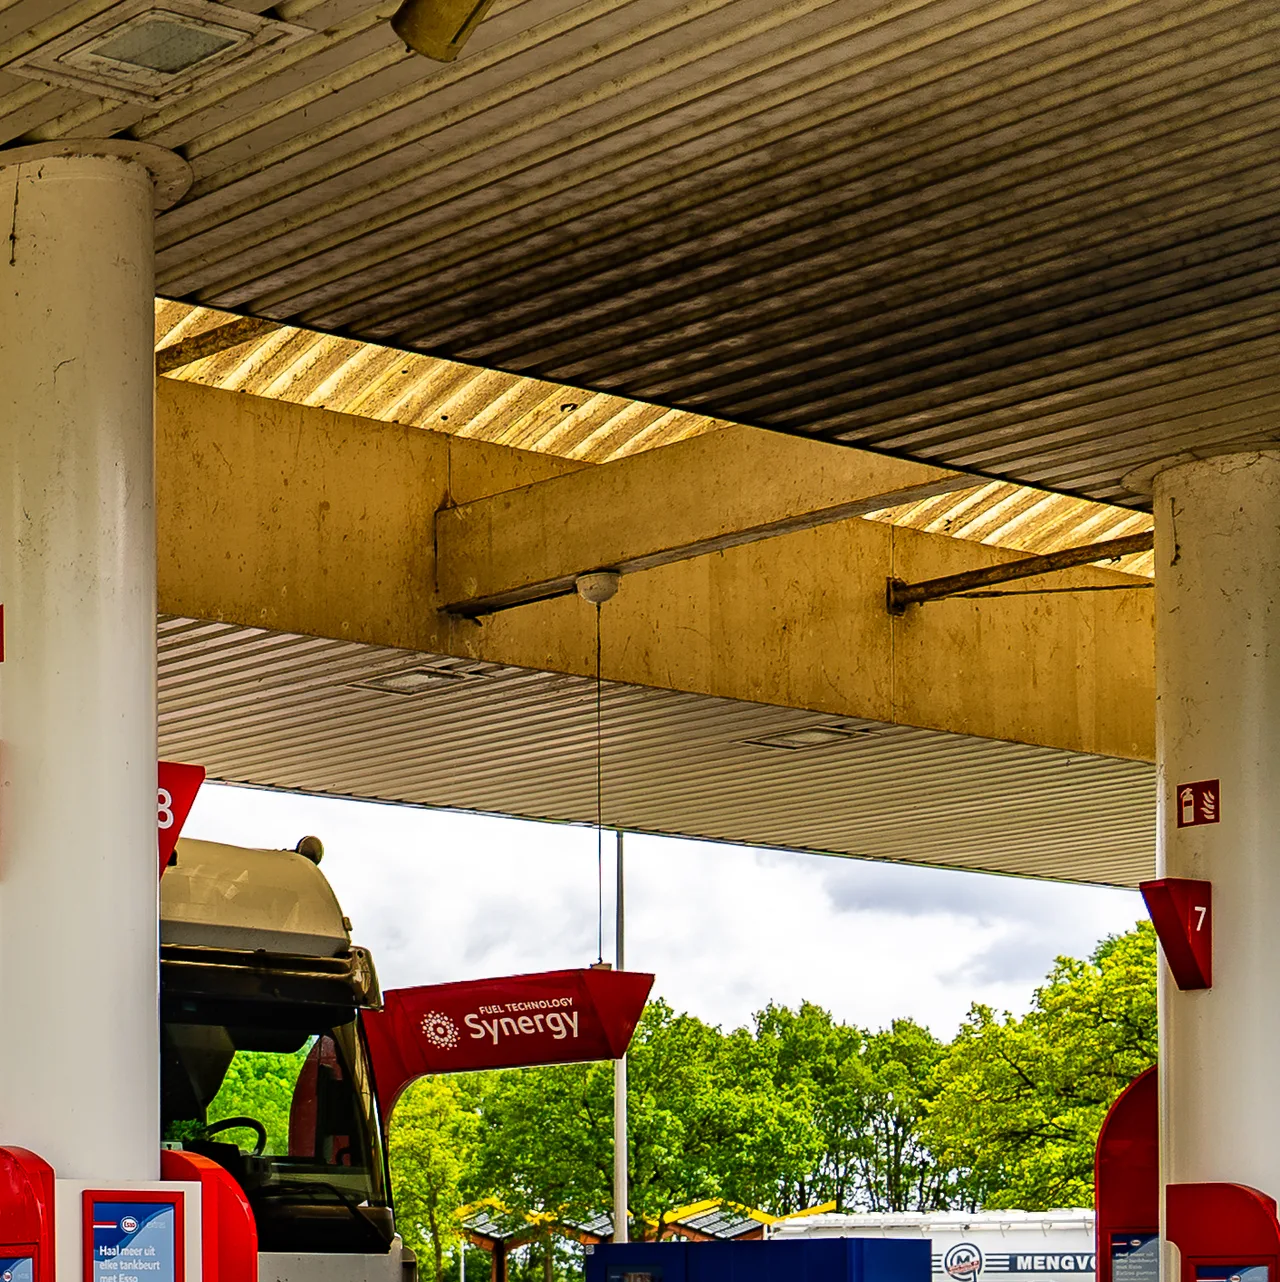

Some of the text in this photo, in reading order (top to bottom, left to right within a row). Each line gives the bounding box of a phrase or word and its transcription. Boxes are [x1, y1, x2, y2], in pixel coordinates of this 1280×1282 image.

[158, 787, 175, 829] 8
[1194, 906, 1207, 931] 7
[479, 997, 573, 1015] FUEL TECHNOLOGY
[464, 1011, 579, 1045] Synergy
[100, 1245, 156, 1256] Haal meer uit
[99, 1259, 161, 1270] elke tankbeurt
